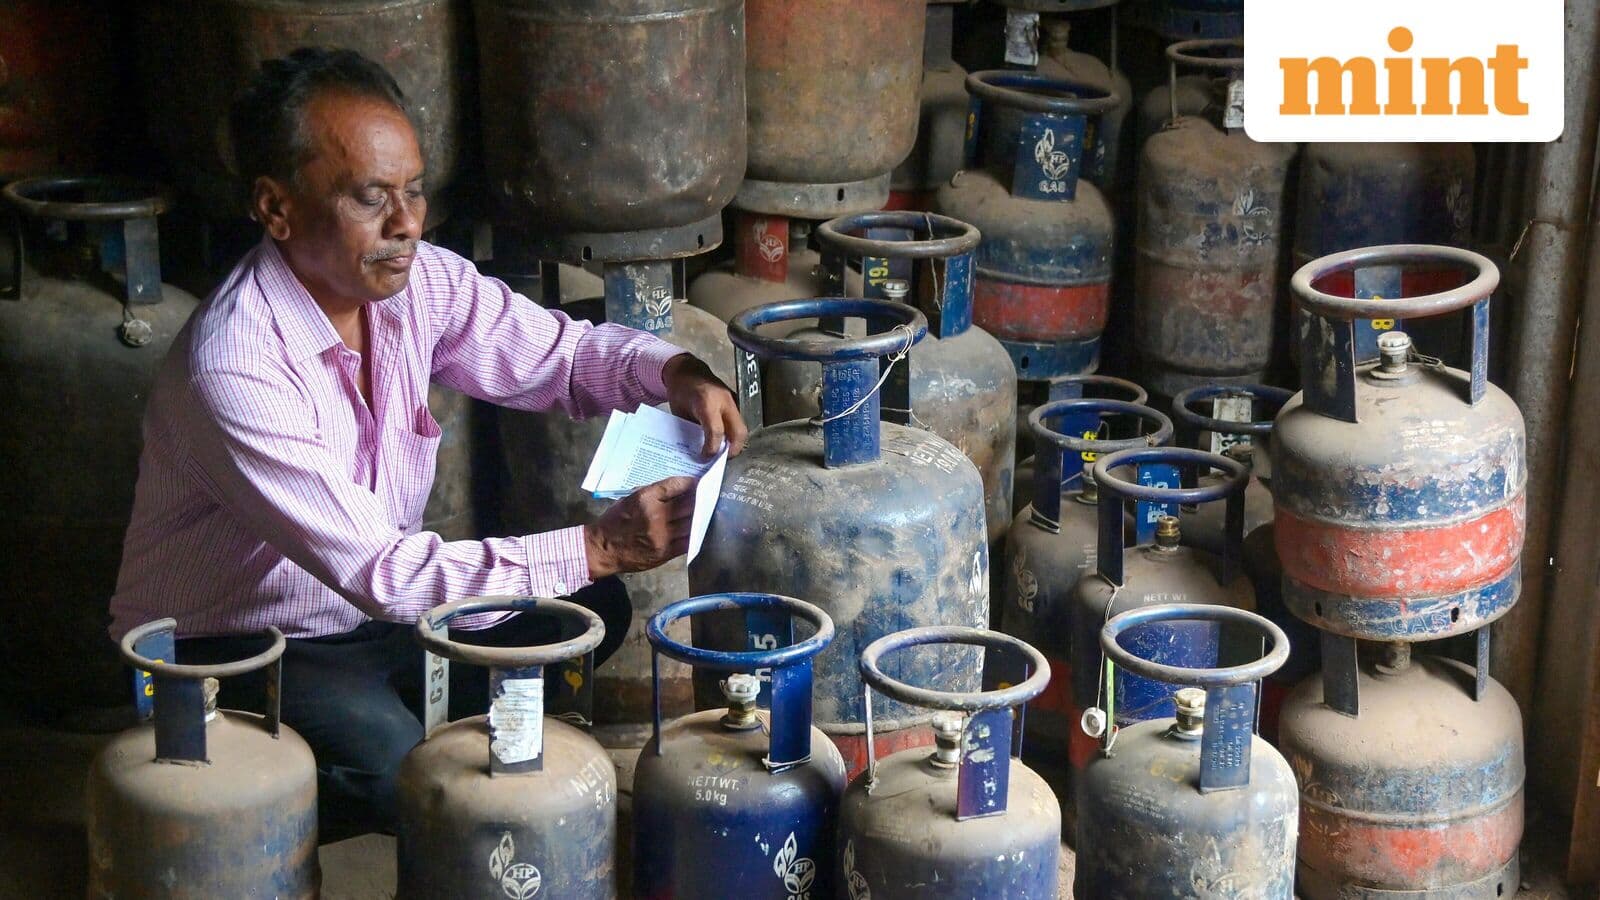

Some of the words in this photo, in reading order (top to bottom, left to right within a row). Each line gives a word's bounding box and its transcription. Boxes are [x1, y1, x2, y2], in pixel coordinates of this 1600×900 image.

[652, 289, 667, 299] HP
[645, 316, 674, 331] GAS
[687, 775, 718, 787] NETT
[695, 789, 727, 806] 5.0kg
[512, 867, 534, 879] HP
